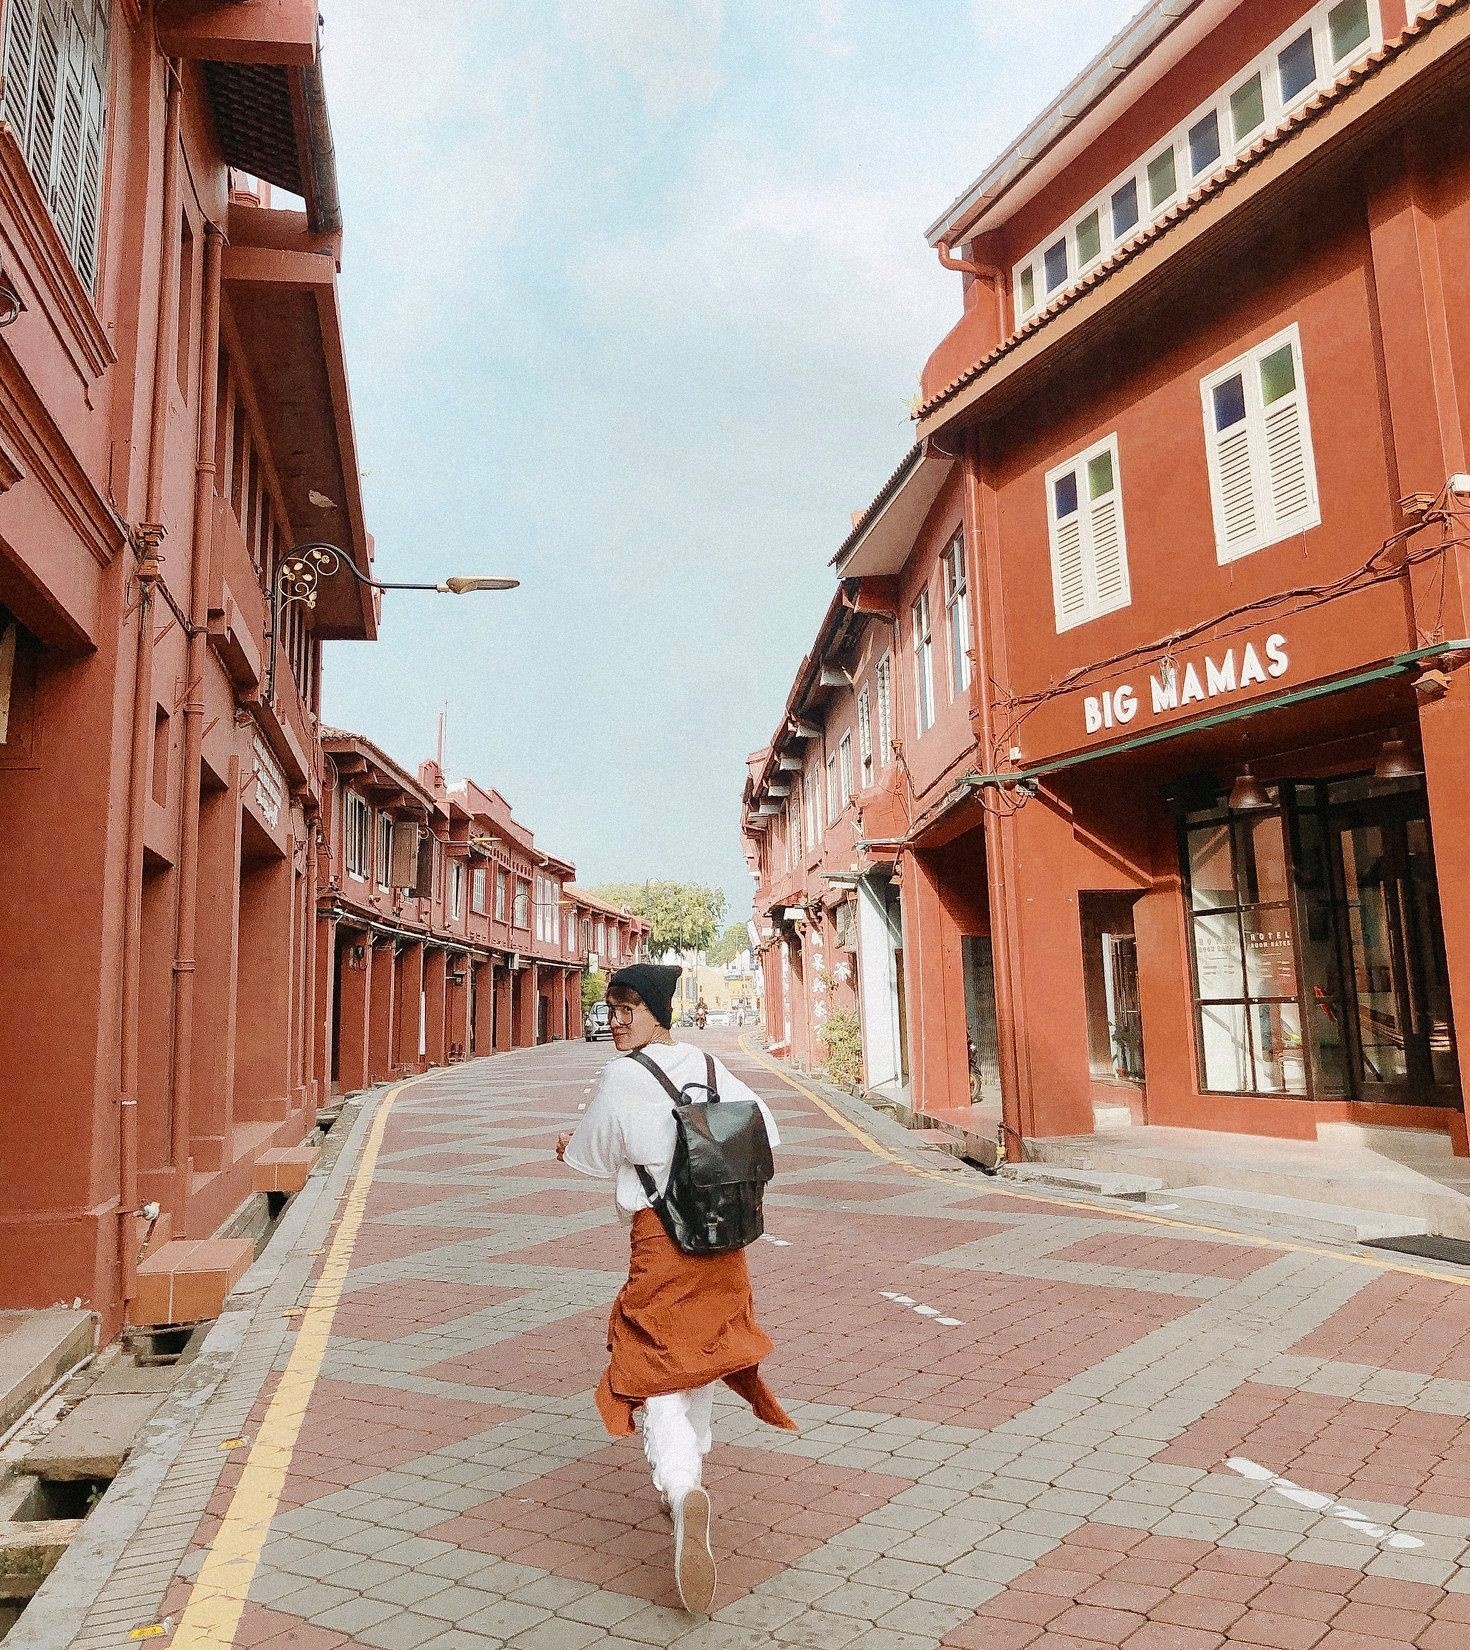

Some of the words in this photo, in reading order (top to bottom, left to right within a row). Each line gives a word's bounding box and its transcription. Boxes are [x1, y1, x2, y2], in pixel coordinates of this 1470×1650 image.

[1083, 685, 1137, 734] BIG
[1150, 633, 1289, 714] MAMAS
[1250, 931, 1290, 941] HOTEL
